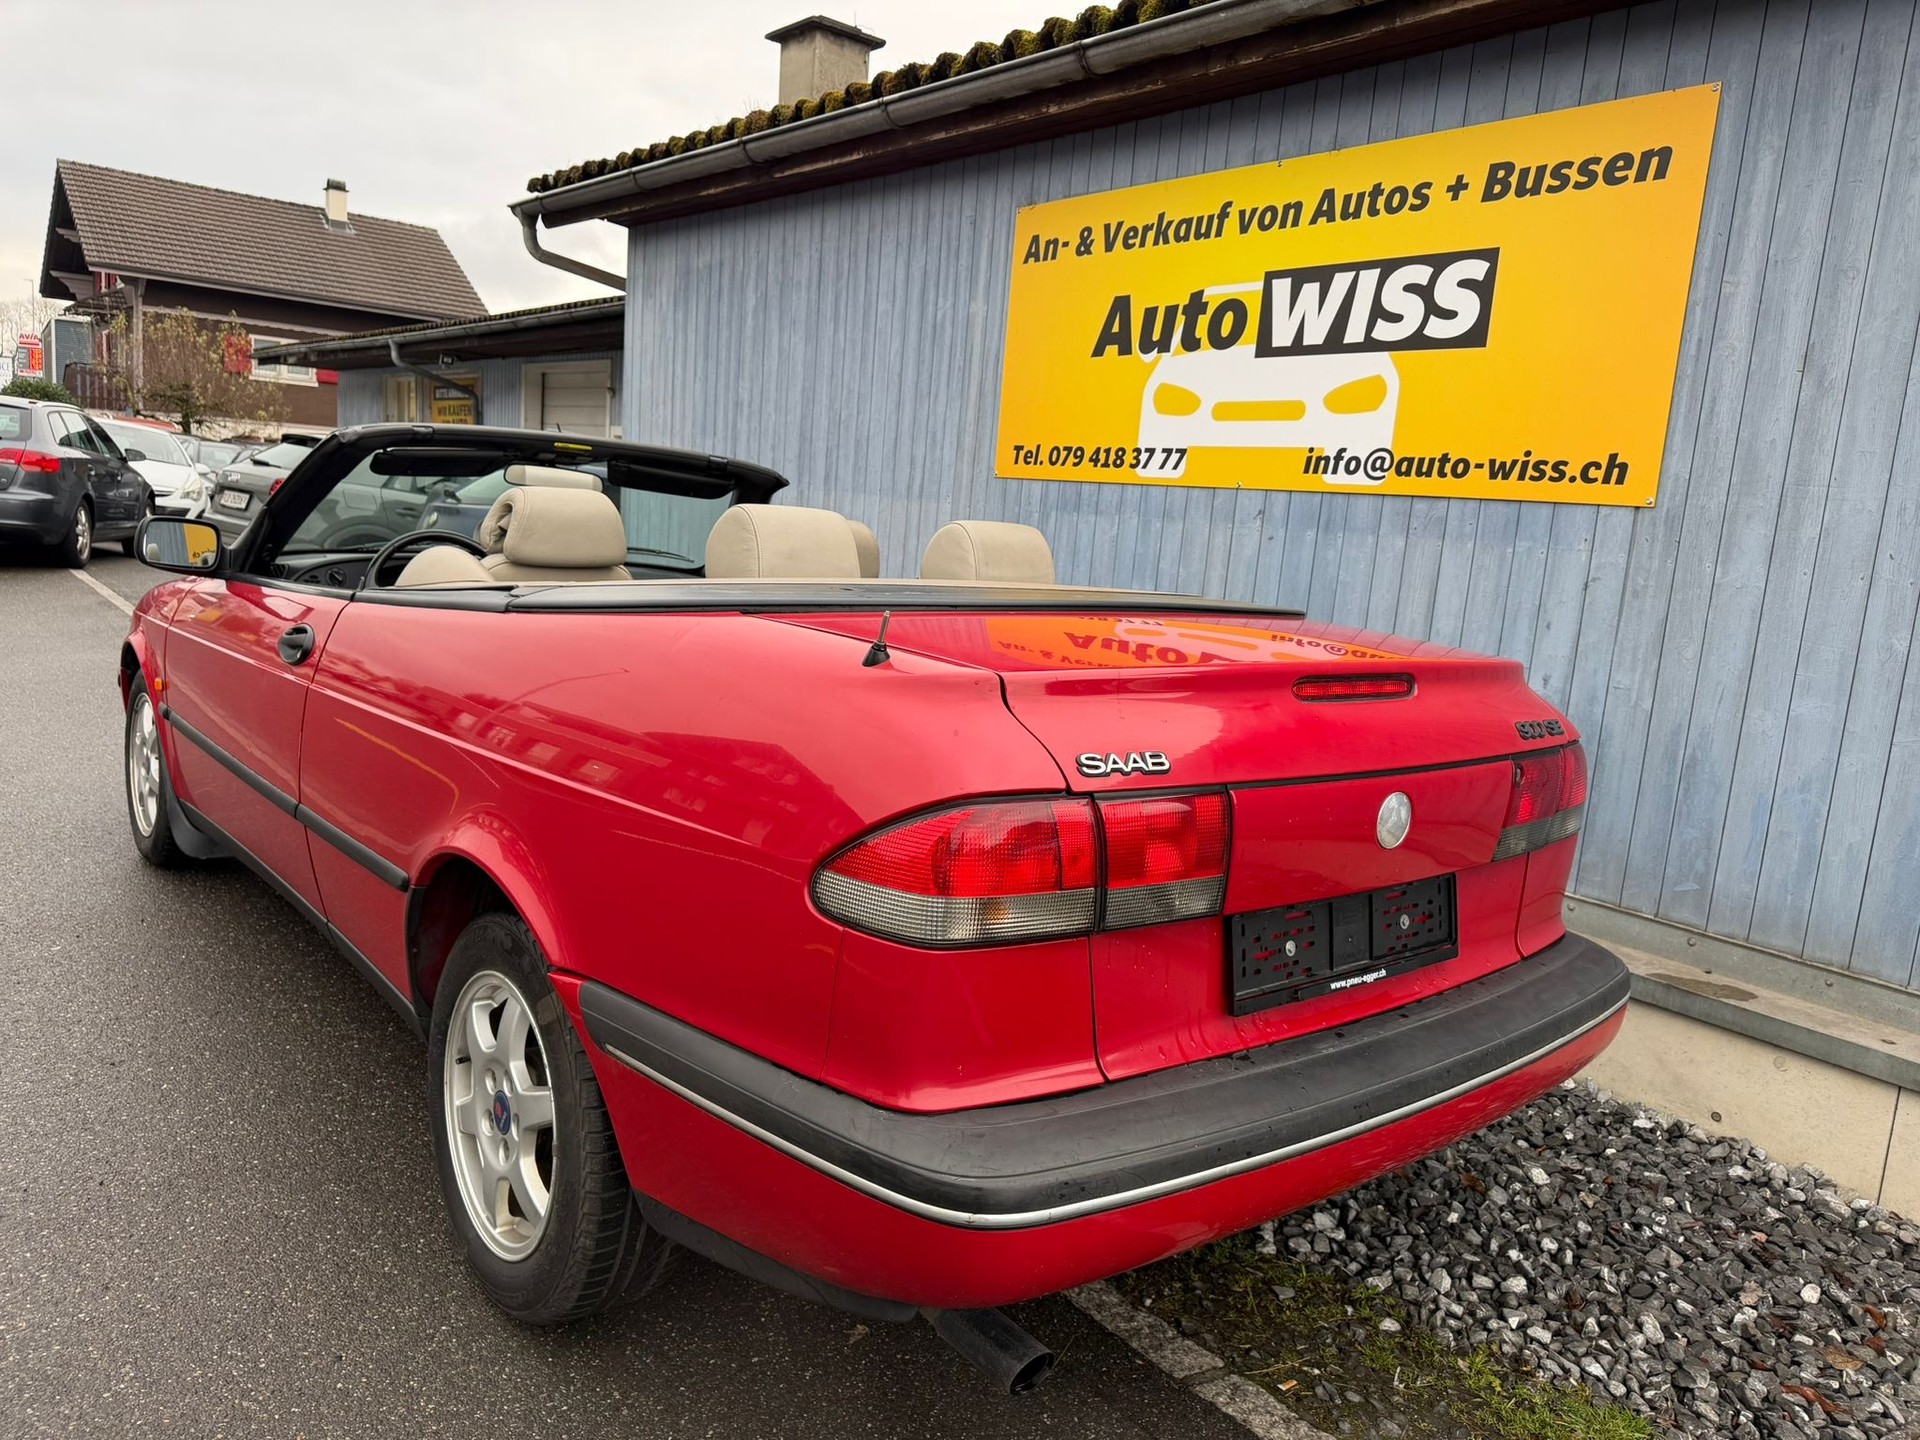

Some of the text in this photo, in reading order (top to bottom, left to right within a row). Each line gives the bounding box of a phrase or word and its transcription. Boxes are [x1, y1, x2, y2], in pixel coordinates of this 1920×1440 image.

[1023, 146, 1673, 264] An- & Verkauf von Autos + Bussen
[1091, 258, 1493, 358] Auto WISS
[1013, 444, 1188, 470] Tel. 079 418 37 77
[1303, 447, 1629, 485] info@auto-wiss.ch
[1076, 751, 1172, 778] SAAB
[1329, 968, 1387, 990] www.pneu-egger.ch
